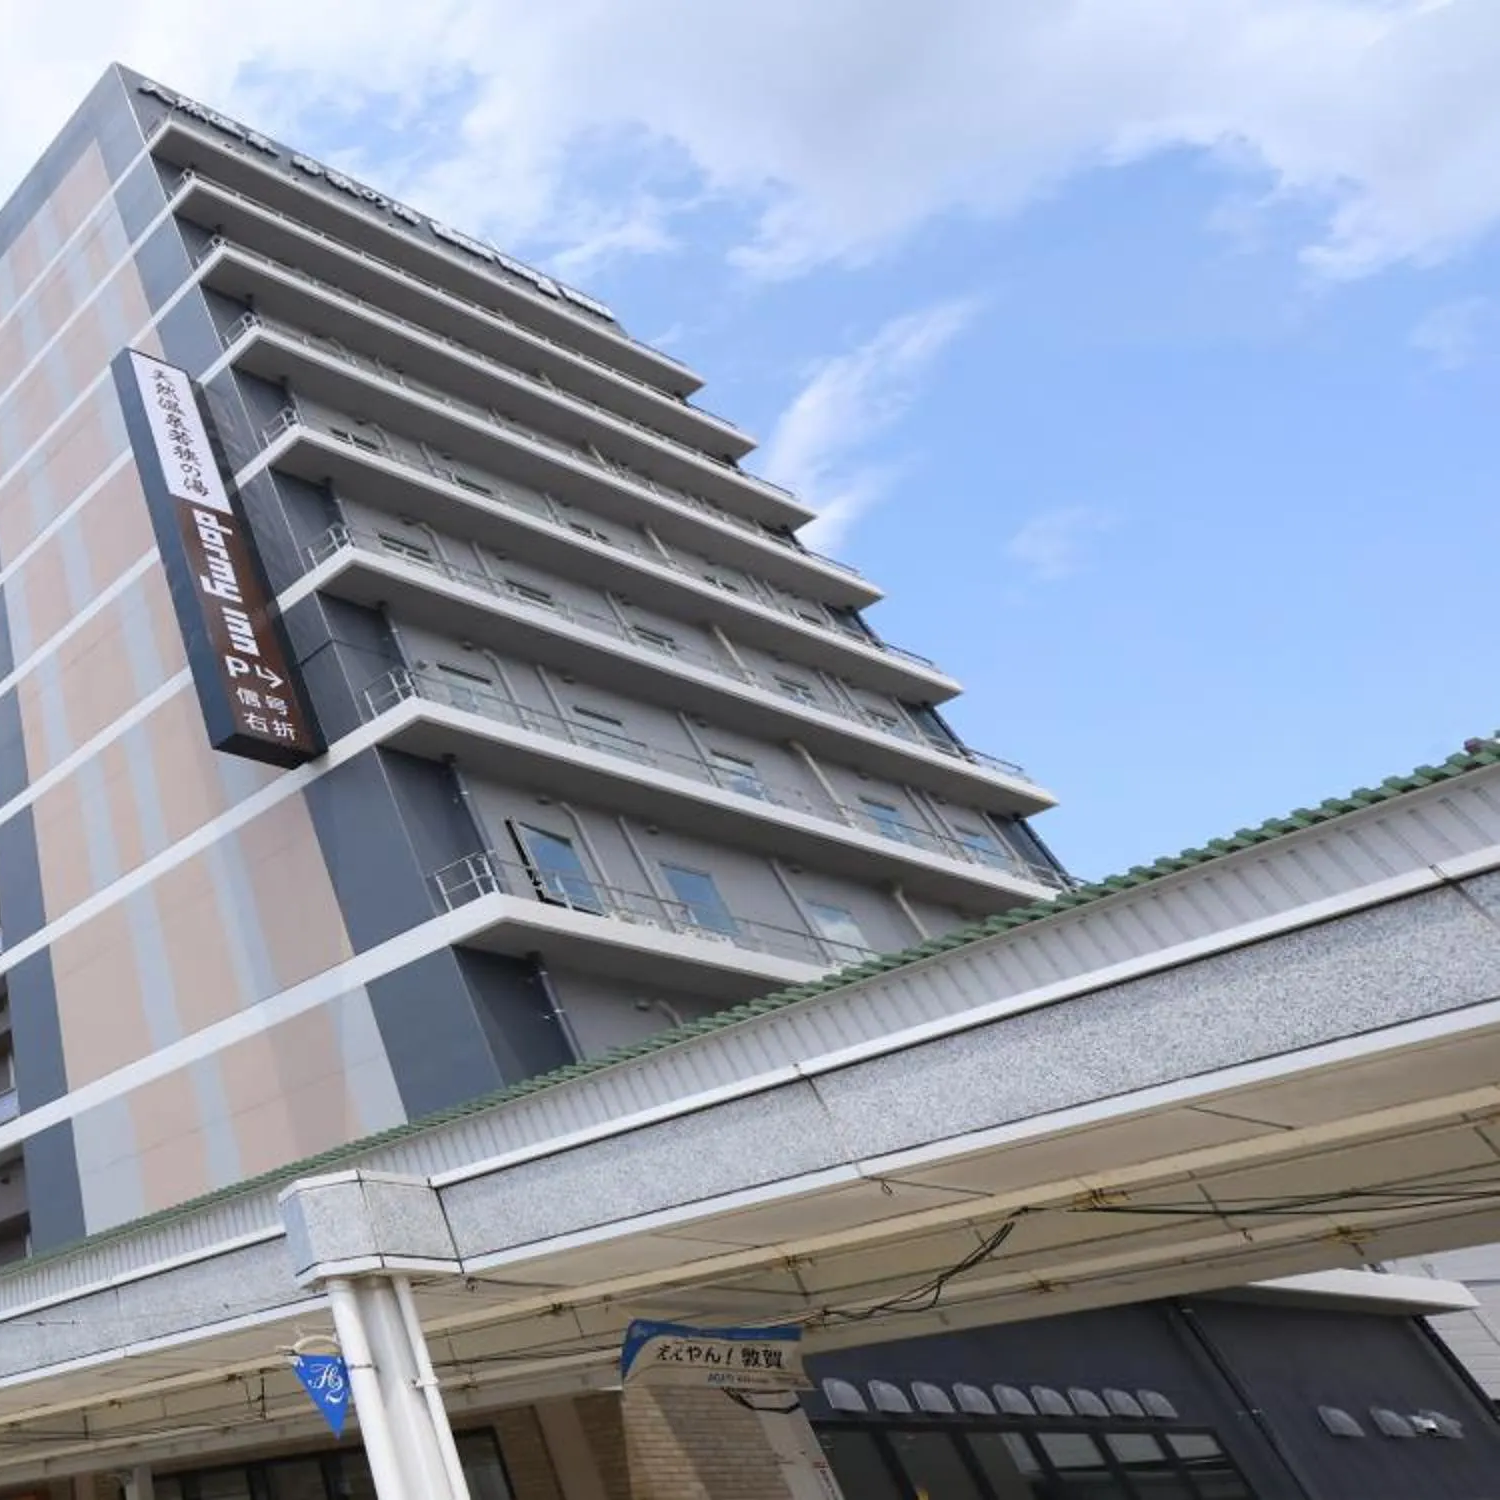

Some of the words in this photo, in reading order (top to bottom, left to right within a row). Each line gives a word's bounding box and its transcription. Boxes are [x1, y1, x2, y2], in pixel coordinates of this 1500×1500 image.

[192, 509, 242, 603] dormy
[222, 606, 260, 657] inn
[225, 655, 250, 678] P
[243, 712, 297, 741] 右折
